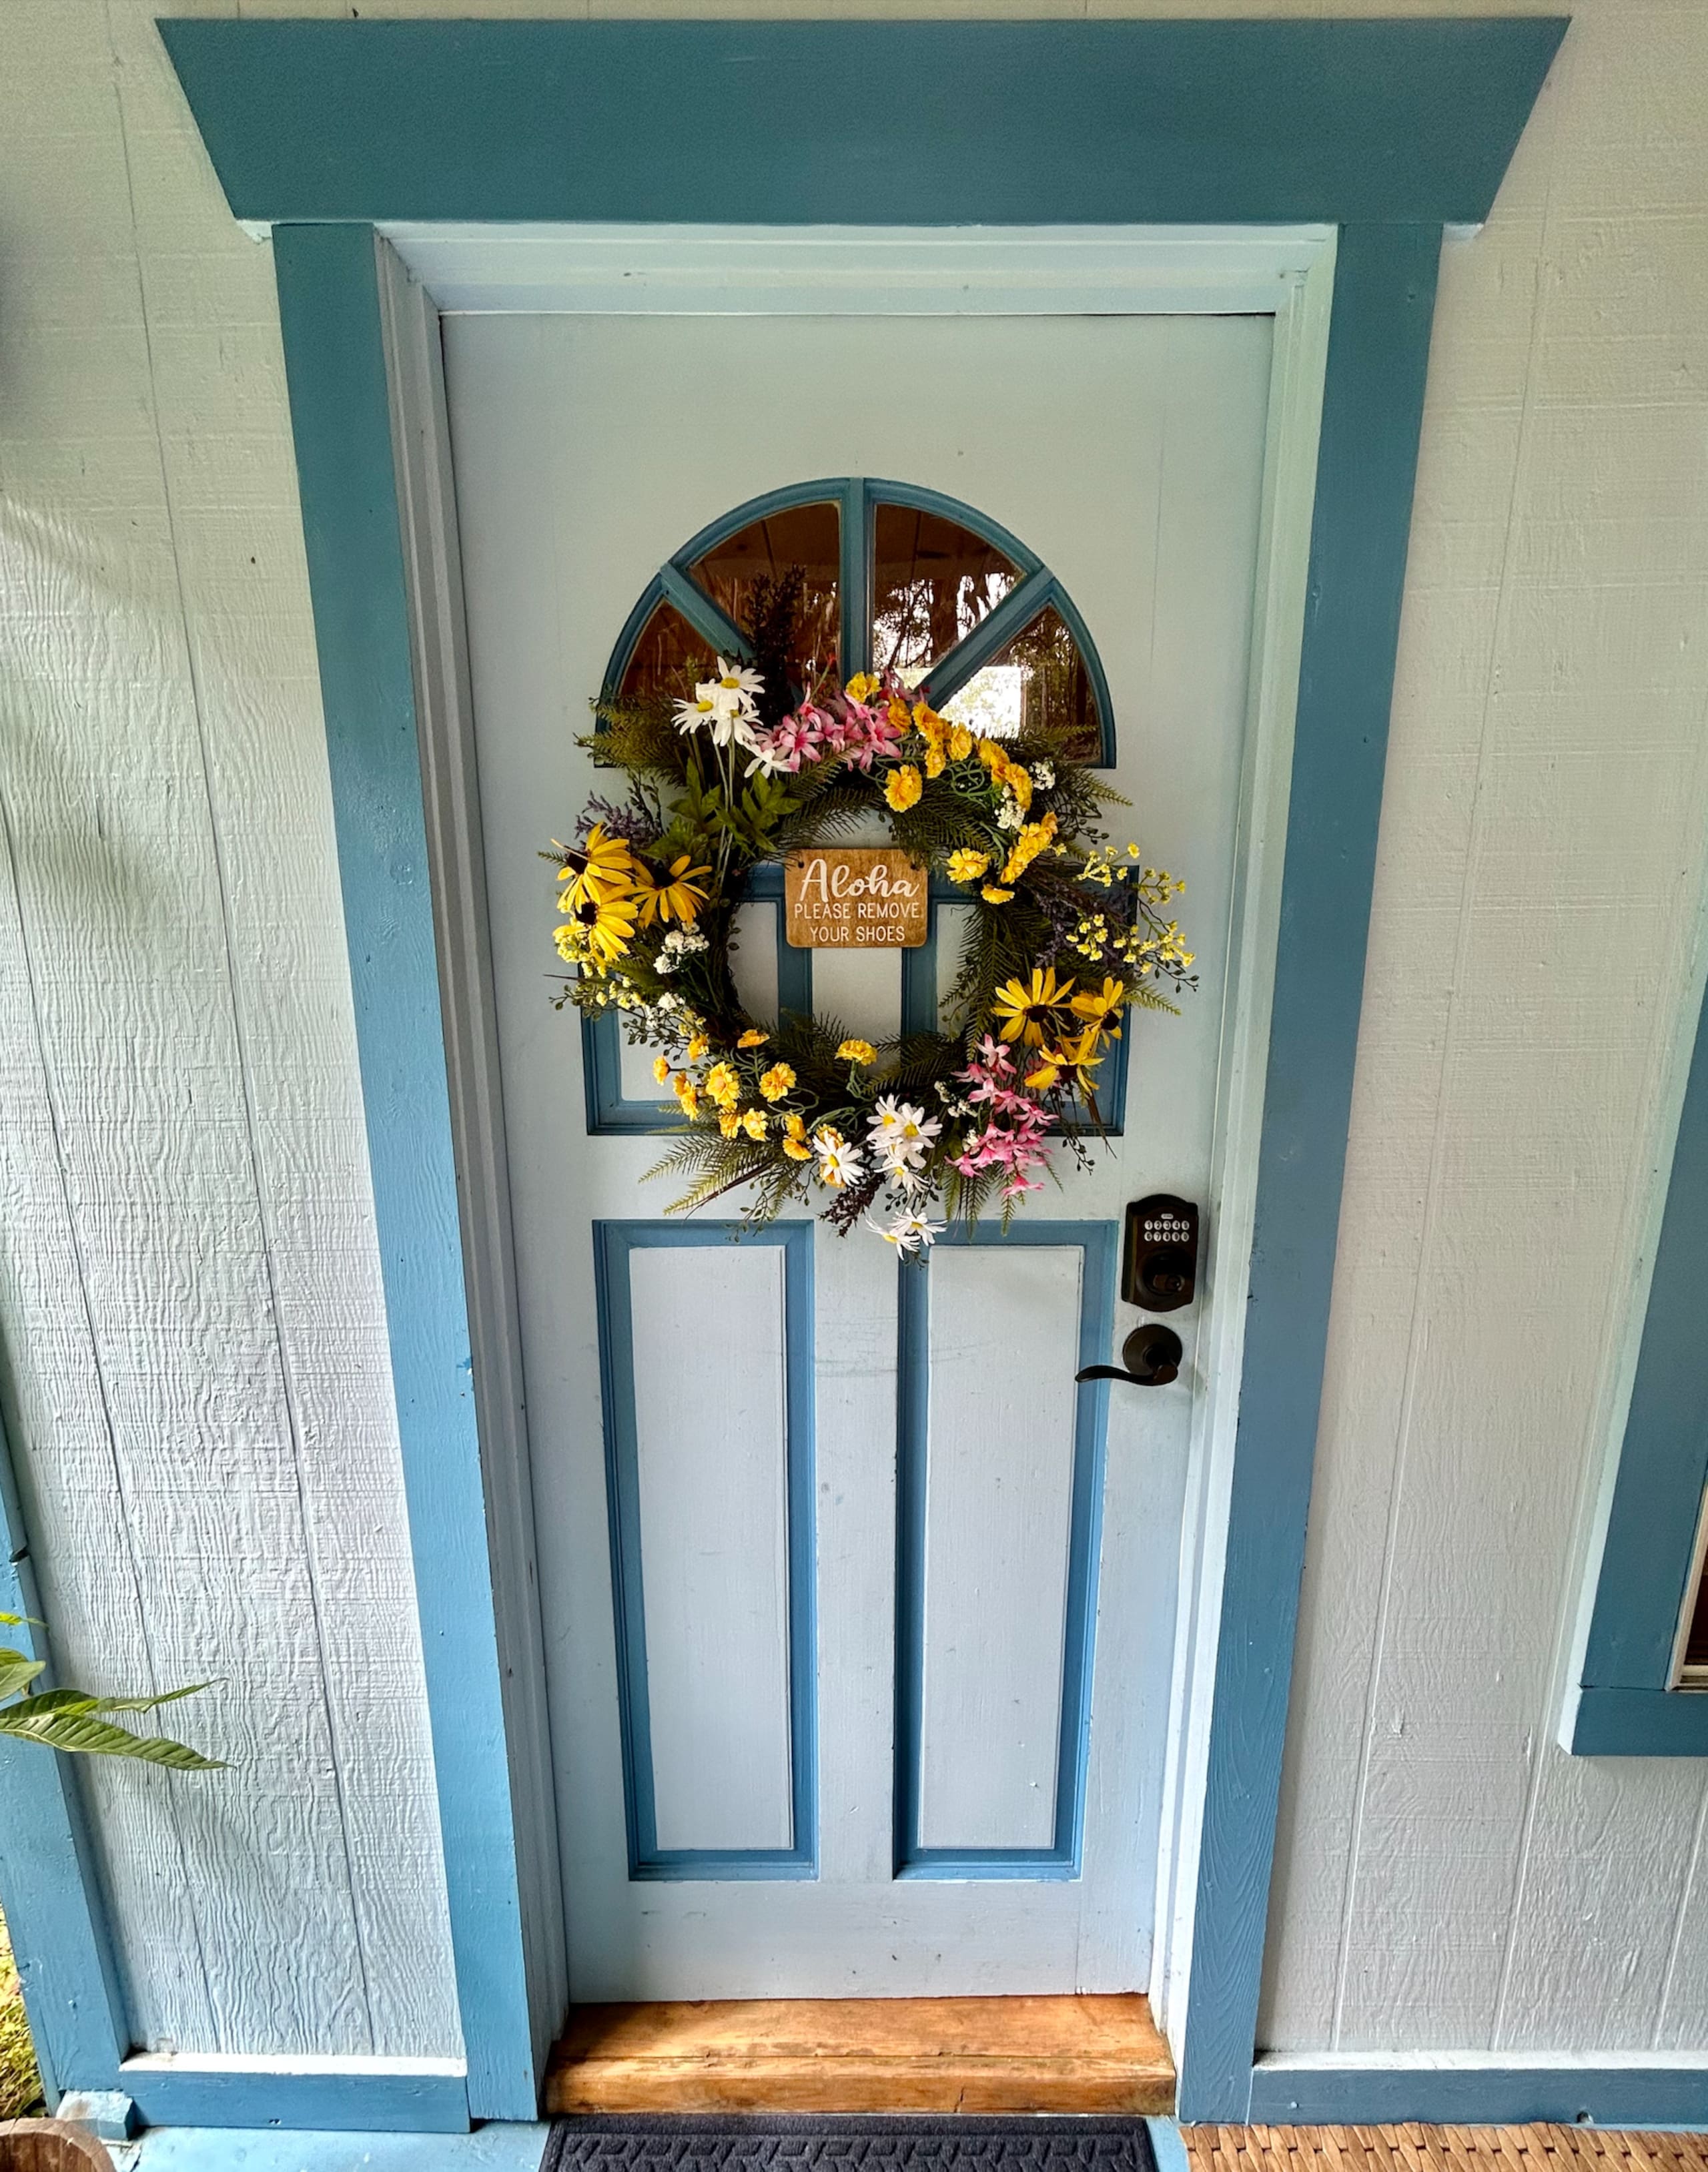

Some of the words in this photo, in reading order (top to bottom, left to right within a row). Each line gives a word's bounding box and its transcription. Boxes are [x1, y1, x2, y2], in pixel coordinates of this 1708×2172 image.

[800, 858, 920, 903] Aloha
[795, 903, 851, 920] PLEASE
[857, 902, 920, 919] REMOVE
[809, 926, 850, 942] YOUR
[855, 926, 905, 942] SHOES
